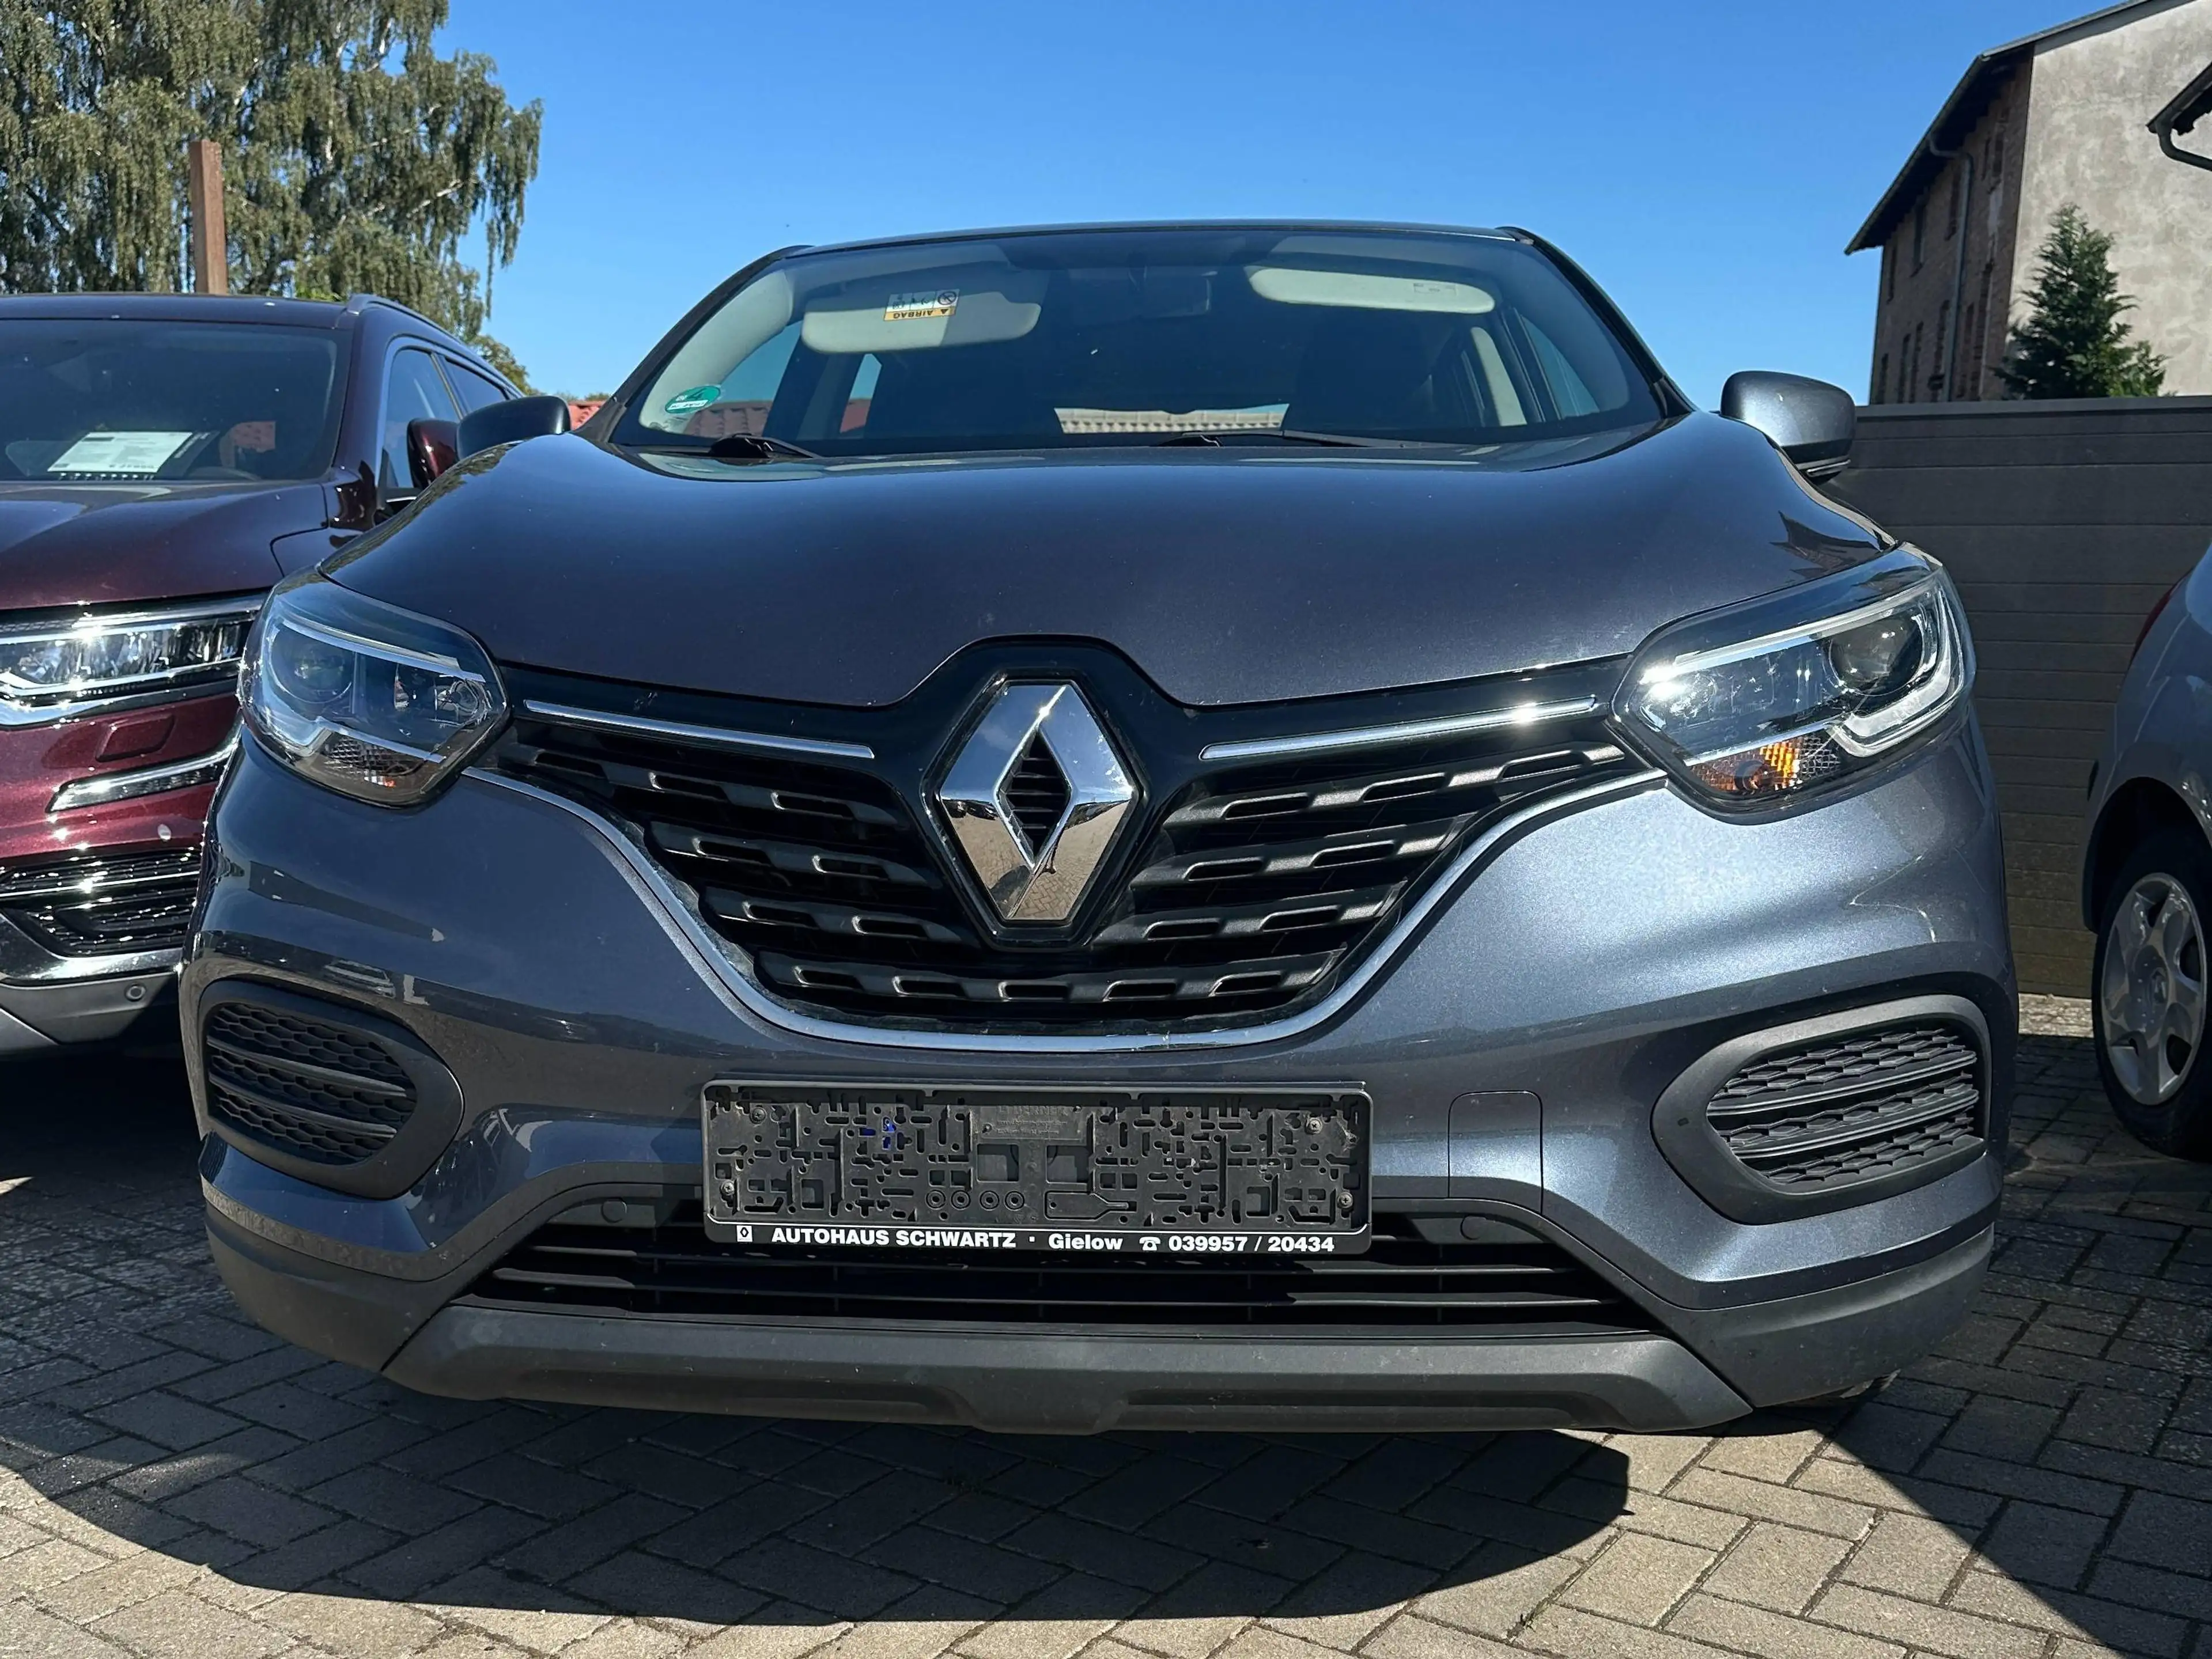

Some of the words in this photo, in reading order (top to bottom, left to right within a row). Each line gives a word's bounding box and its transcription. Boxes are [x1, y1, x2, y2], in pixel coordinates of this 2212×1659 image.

[893, 309, 934, 319] AIRBAG
[772, 1228, 890, 1245] AUTOHAUS
[895, 1230, 1016, 1248] SCHWARTZ
[1048, 1233, 1124, 1250] Gielow
[1168, 1235, 1248, 1252] 039957
[1267, 1236, 1335, 1252] 20434
